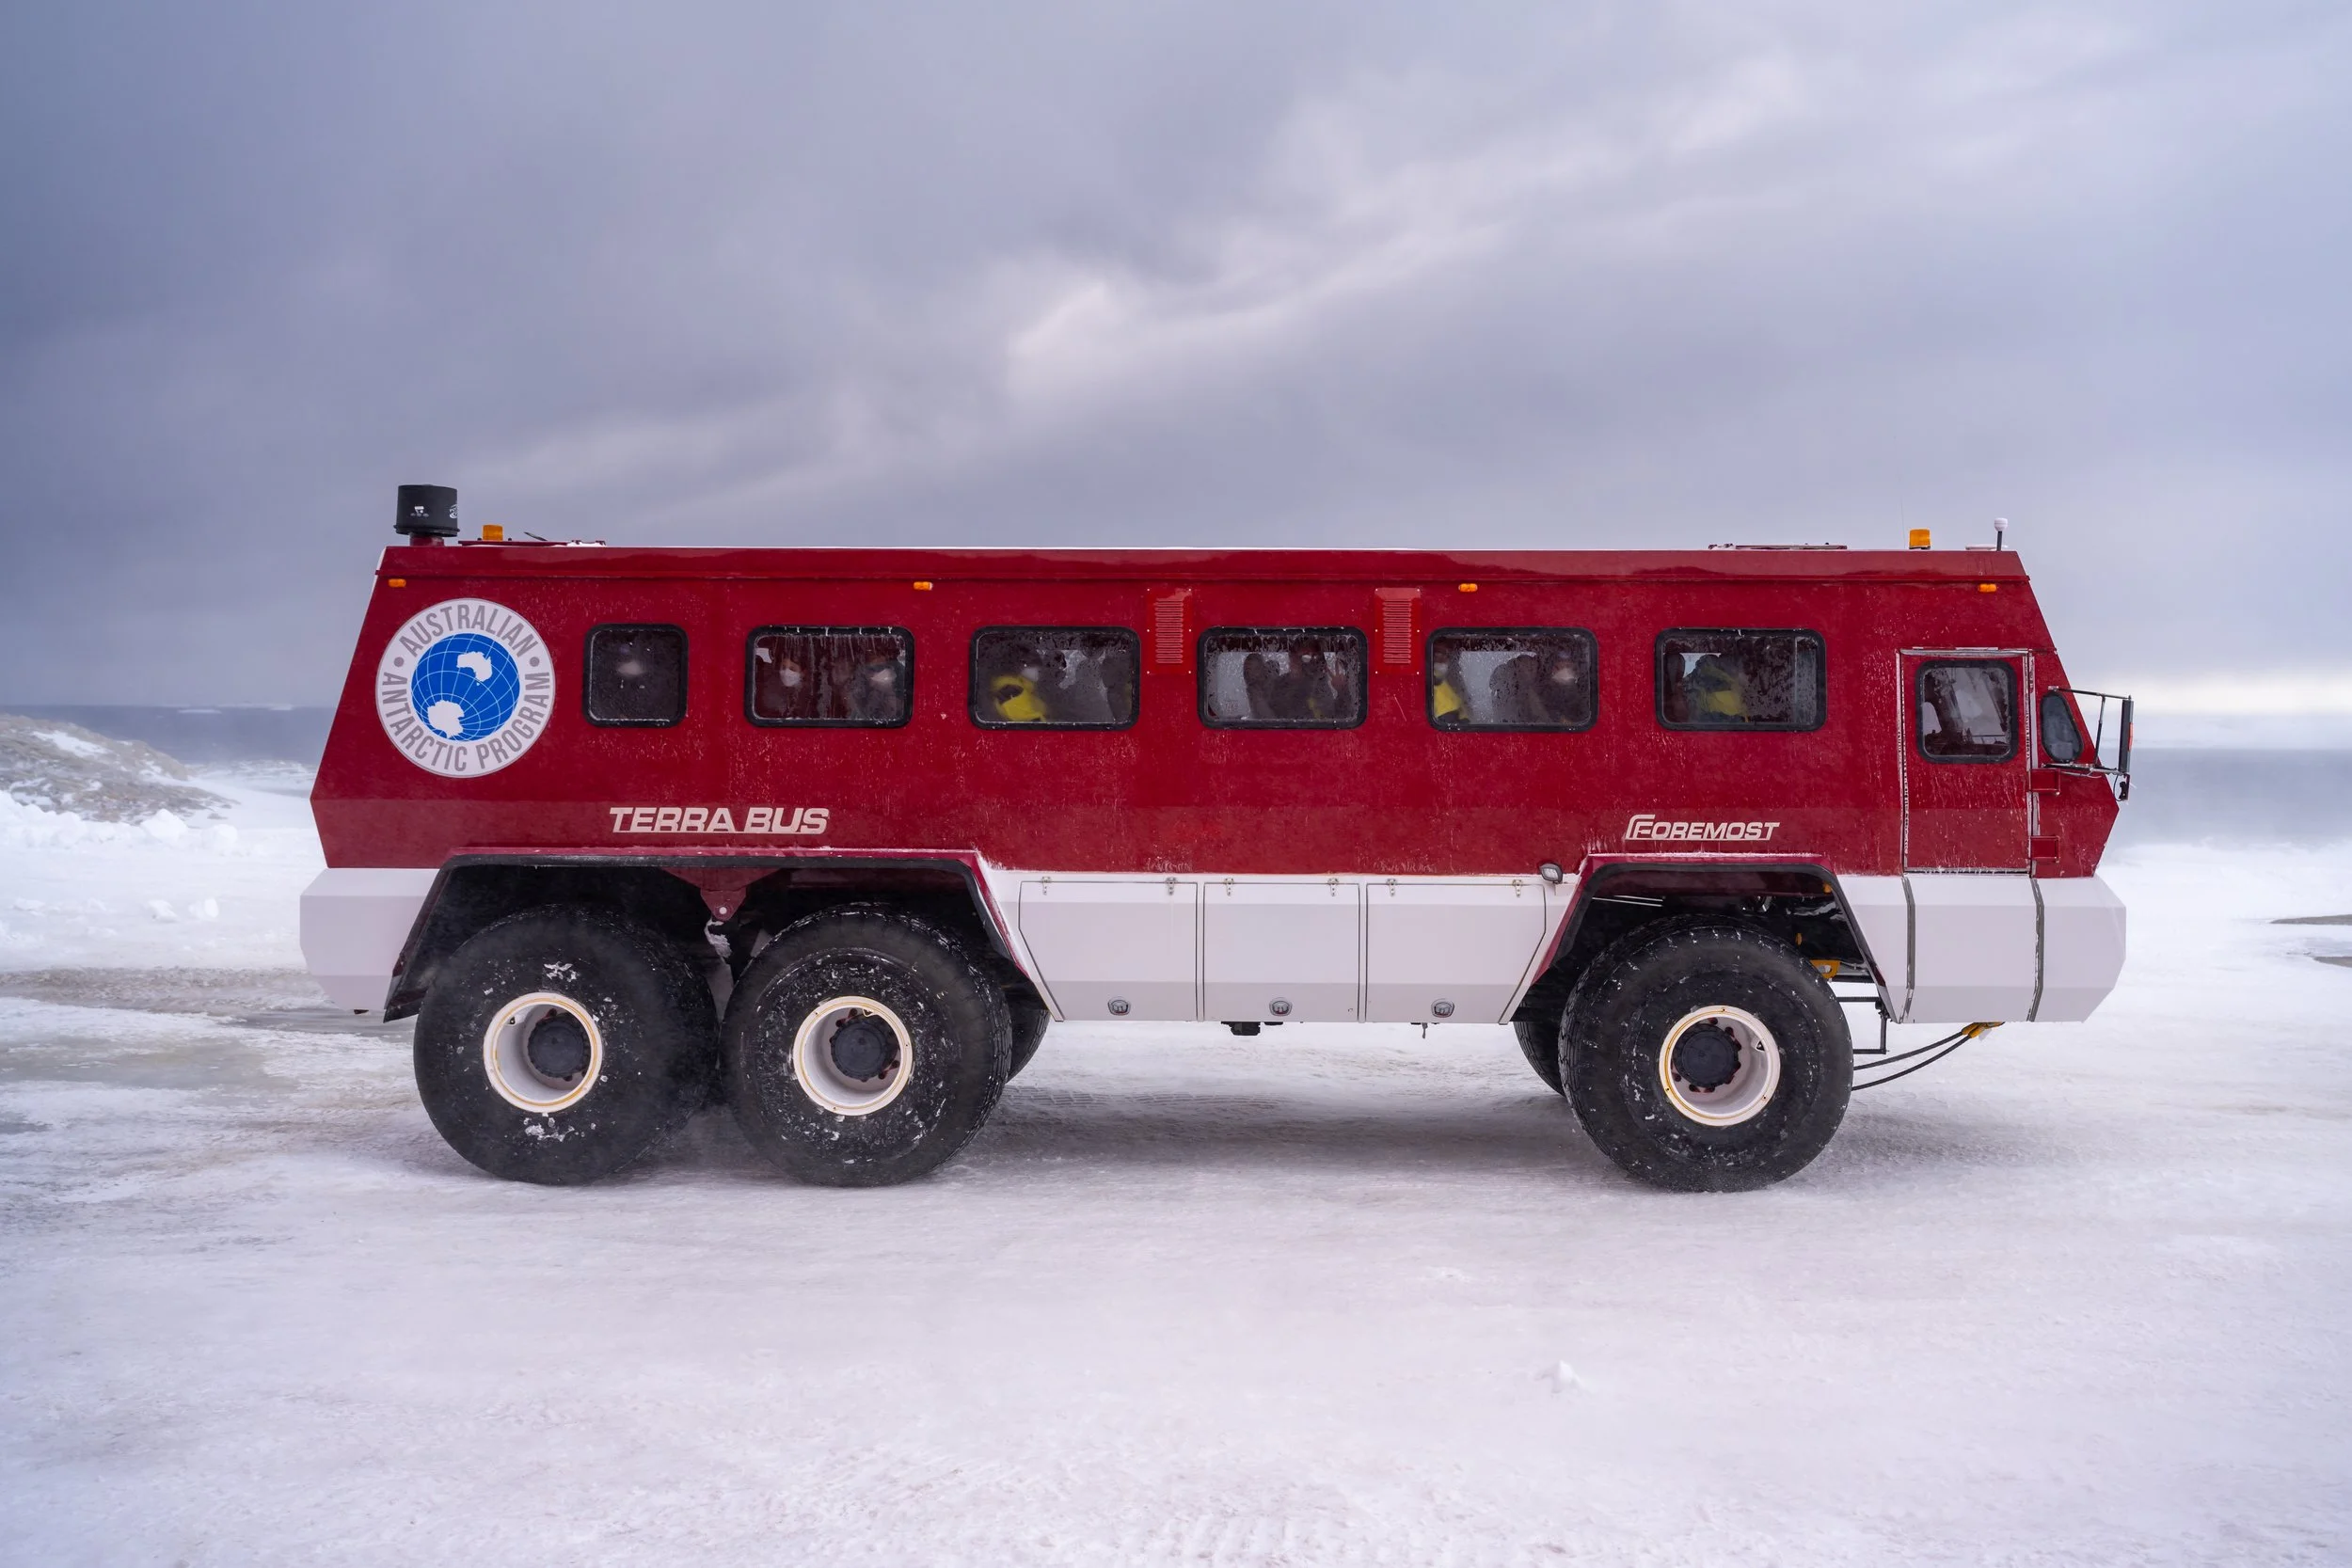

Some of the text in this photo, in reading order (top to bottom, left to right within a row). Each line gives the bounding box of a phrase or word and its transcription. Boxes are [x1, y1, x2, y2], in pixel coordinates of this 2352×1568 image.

[399, 604, 538, 657] AUSTRALIAN
[382, 672, 550, 771] ANTARCTIC PROGRAM
[610, 807, 830, 834] TERRA BUS
[1625, 814, 1780, 841] FOREMOST
